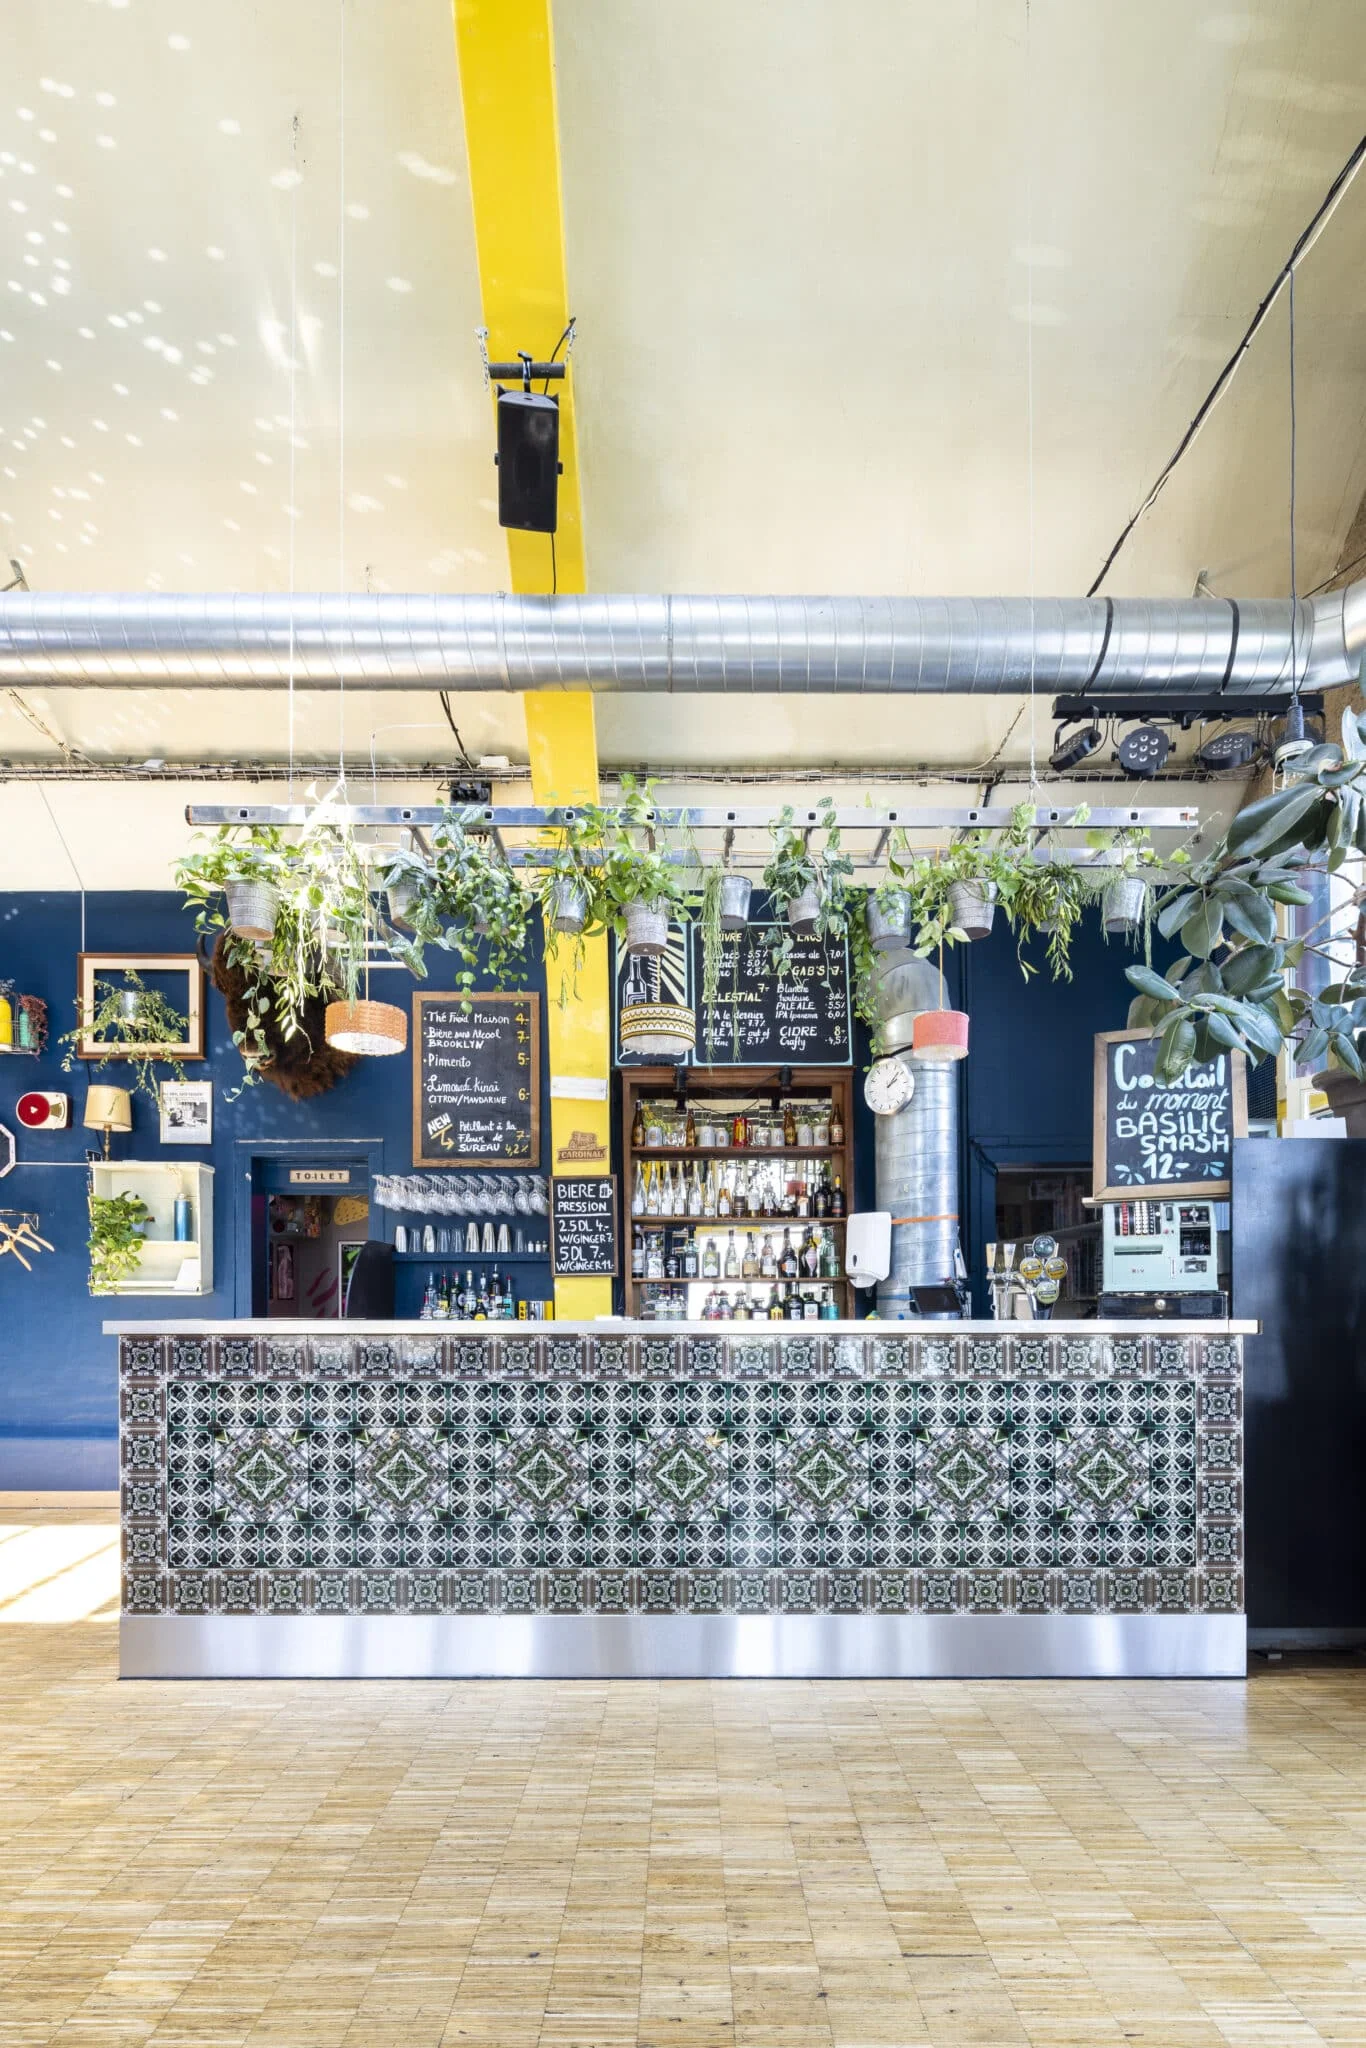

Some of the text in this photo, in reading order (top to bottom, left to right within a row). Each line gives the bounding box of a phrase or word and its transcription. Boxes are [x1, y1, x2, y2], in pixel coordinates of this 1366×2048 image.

[776, 1001, 796, 1010] PALE
[796, 1001, 817, 1010] ALE
[427, 1011, 447, 1023] Thé
[474, 1013, 510, 1024] Maison
[472, 1028, 501, 1039] Alcool
[727, 1026, 747, 1037] AE
[780, 1025, 818, 1037] CIDRE
[427, 1038, 485, 1050] BROOKLYN
[1116, 1088, 1230, 1111] du moment
[427, 1112, 452, 1135] NEW
[493, 1132, 504, 1142] de
[458, 1143, 500, 1153] SUREAU
[1140, 1133, 1230, 1155] SMASH
[560, 1149, 604, 1160] CARDINAL
[295, 1172, 345, 1181] TOILET
[578, 1219, 593, 1232] DL
[560, 1246, 569, 1261] 5
[570, 1246, 587, 1261] DL
